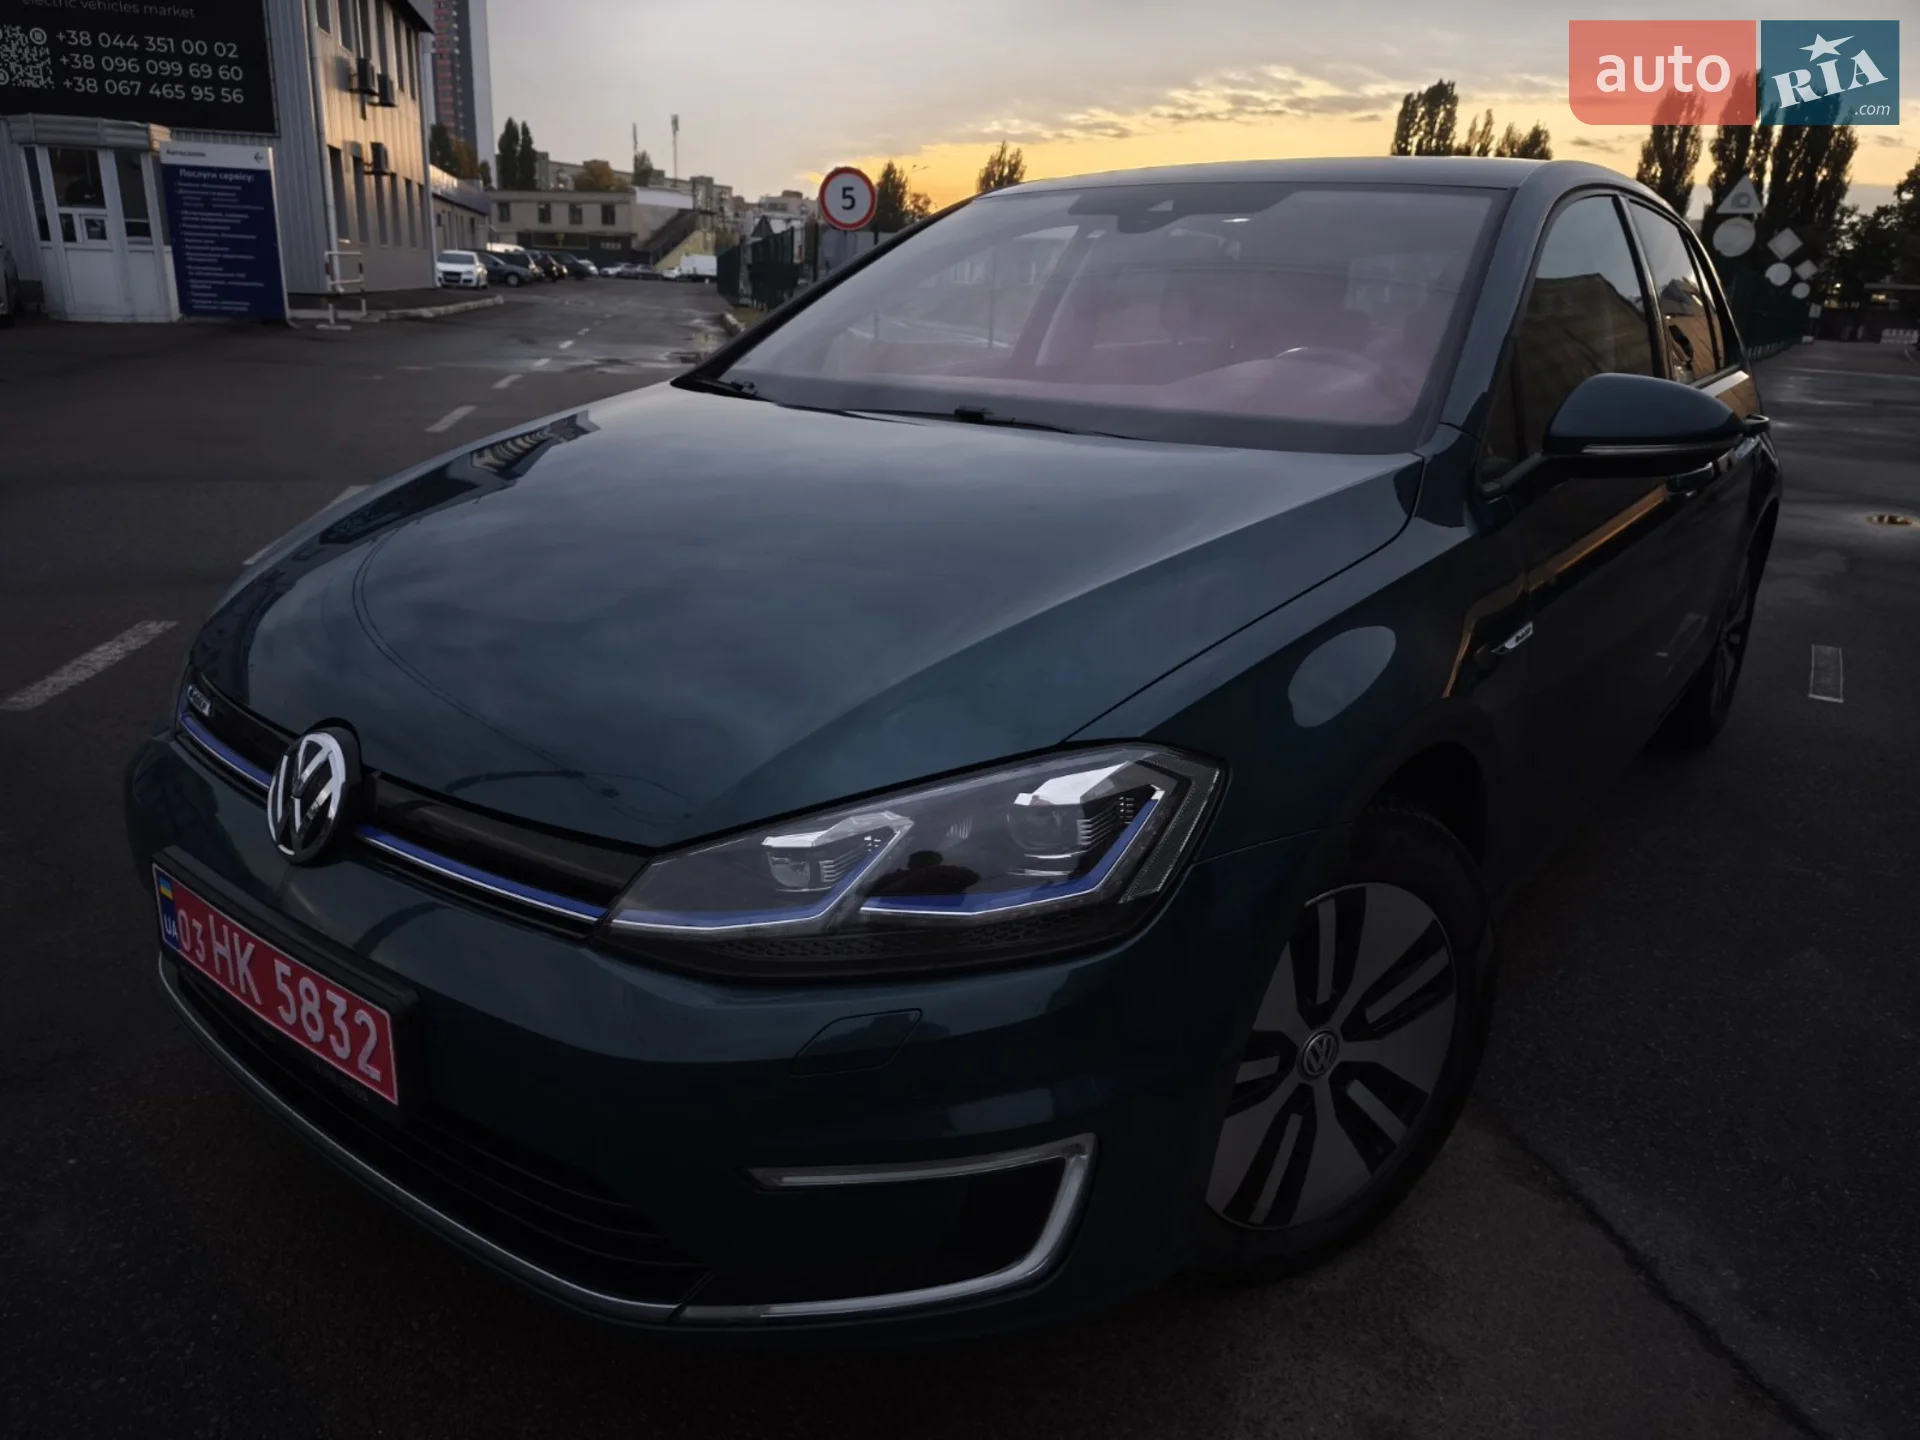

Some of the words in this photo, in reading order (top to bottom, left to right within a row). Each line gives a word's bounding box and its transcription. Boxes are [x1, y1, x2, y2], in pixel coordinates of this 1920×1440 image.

[81, 0, 140, 14] vehicles
[143, 5, 196, 19] market
[56, 29, 92, 47] +38
[98, 32, 139, 50] 044
[144, 36, 174, 53] 351
[181, 39, 208, 56] 00
[214, 41, 239, 58] 02
[60, 53, 95, 70] +38
[101, 56, 140, 73] 096
[145, 59, 183, 77] 099
[188, 62, 212, 79] 69
[218, 65, 243, 81] 60
[63, 76, 98, 93] +38
[105, 79, 141, 96] 067
[149, 82, 186, 99] 465
[191, 85, 215, 102] 95
[220, 87, 244, 104] 56
[841, 186, 856, 211] 5
[164, 915, 180, 942] UA
[274, 958, 381, 1082] 5832
